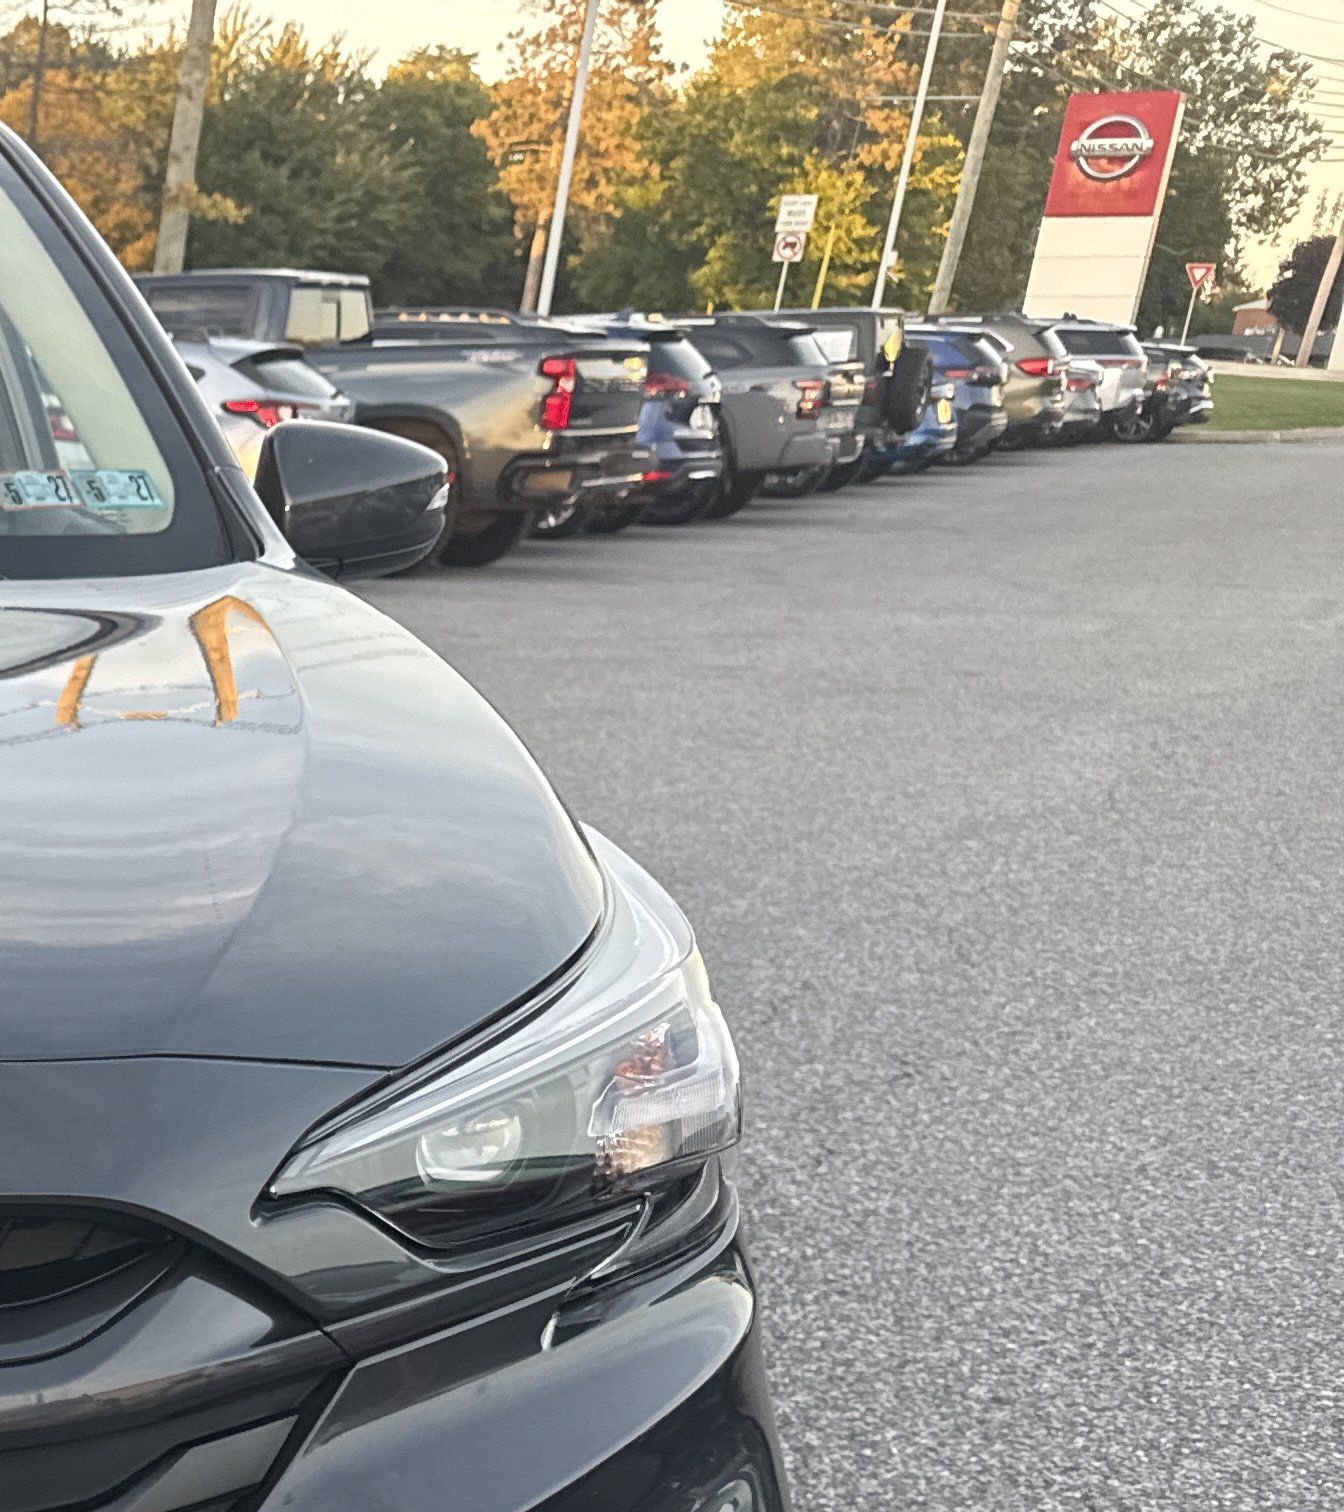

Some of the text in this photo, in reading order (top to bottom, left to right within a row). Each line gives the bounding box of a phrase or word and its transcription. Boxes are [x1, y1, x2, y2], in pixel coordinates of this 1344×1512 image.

[1076, 142, 1144, 154] NISSAN
[47, 475, 73, 503] 27
[127, 475, 155, 502] 27
